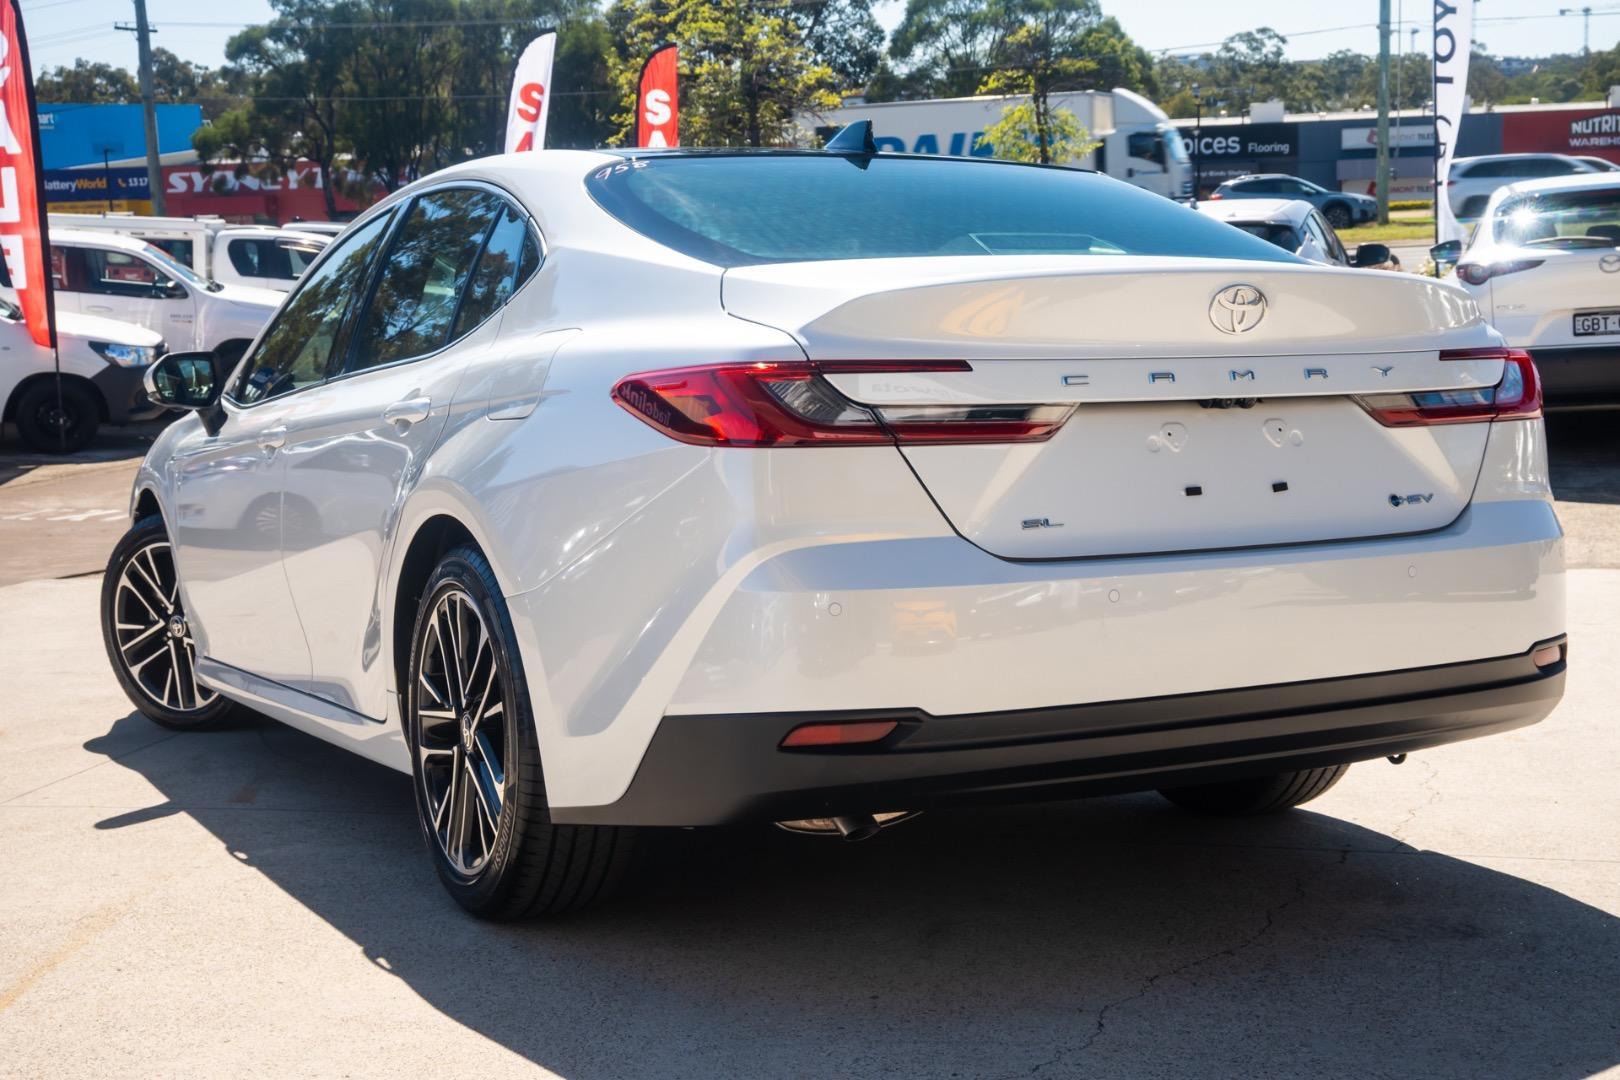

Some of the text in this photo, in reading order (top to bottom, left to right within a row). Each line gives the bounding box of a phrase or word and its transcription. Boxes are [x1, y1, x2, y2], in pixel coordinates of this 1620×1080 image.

[1572, 115, 1620, 134] NUTRI
[1182, 130, 1290, 155] oices Flooring
[1569, 136, 1620, 147] WAREH
[1061, 366, 1394, 387] CAMRY
